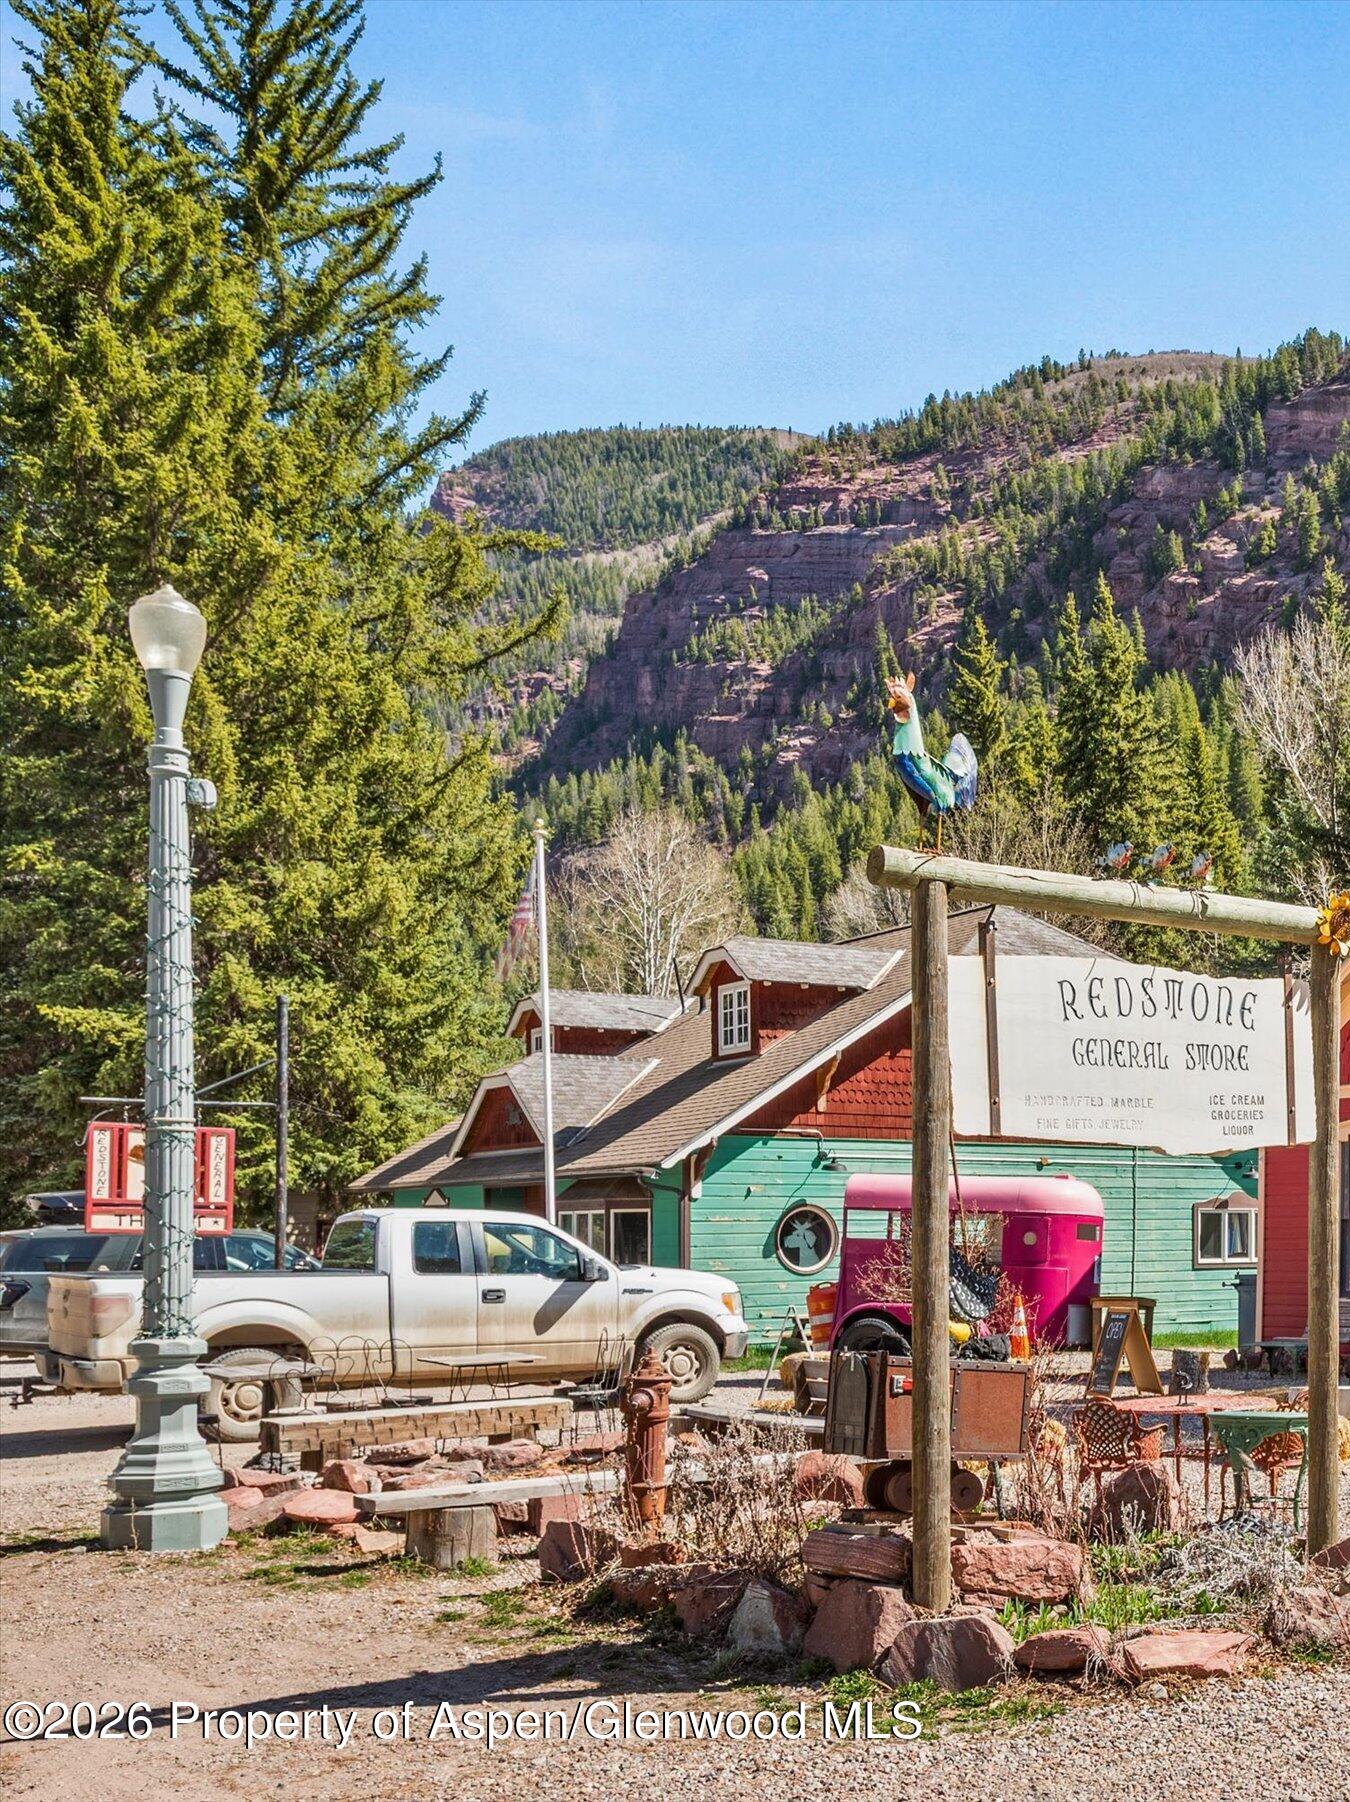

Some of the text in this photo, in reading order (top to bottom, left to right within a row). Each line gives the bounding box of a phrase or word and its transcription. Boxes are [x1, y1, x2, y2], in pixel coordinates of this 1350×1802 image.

[1057, 976, 1259, 1032] REDSTONE
[1072, 1037, 1251, 1071] GENERAL STORE
[1024, 1094, 1155, 1109] HANDCRAFTED MARBLE
[1209, 1094, 1265, 1106] ICE CREAM
[1211, 1109, 1265, 1121] GROCERIES
[1036, 1117, 1145, 1131] FINE GIFTS JEWELRY
[1222, 1124, 1255, 1136] LIQUOR
[95, 1129, 108, 1197] REDSTONE
[211, 1134, 227, 1199] GENERAL
